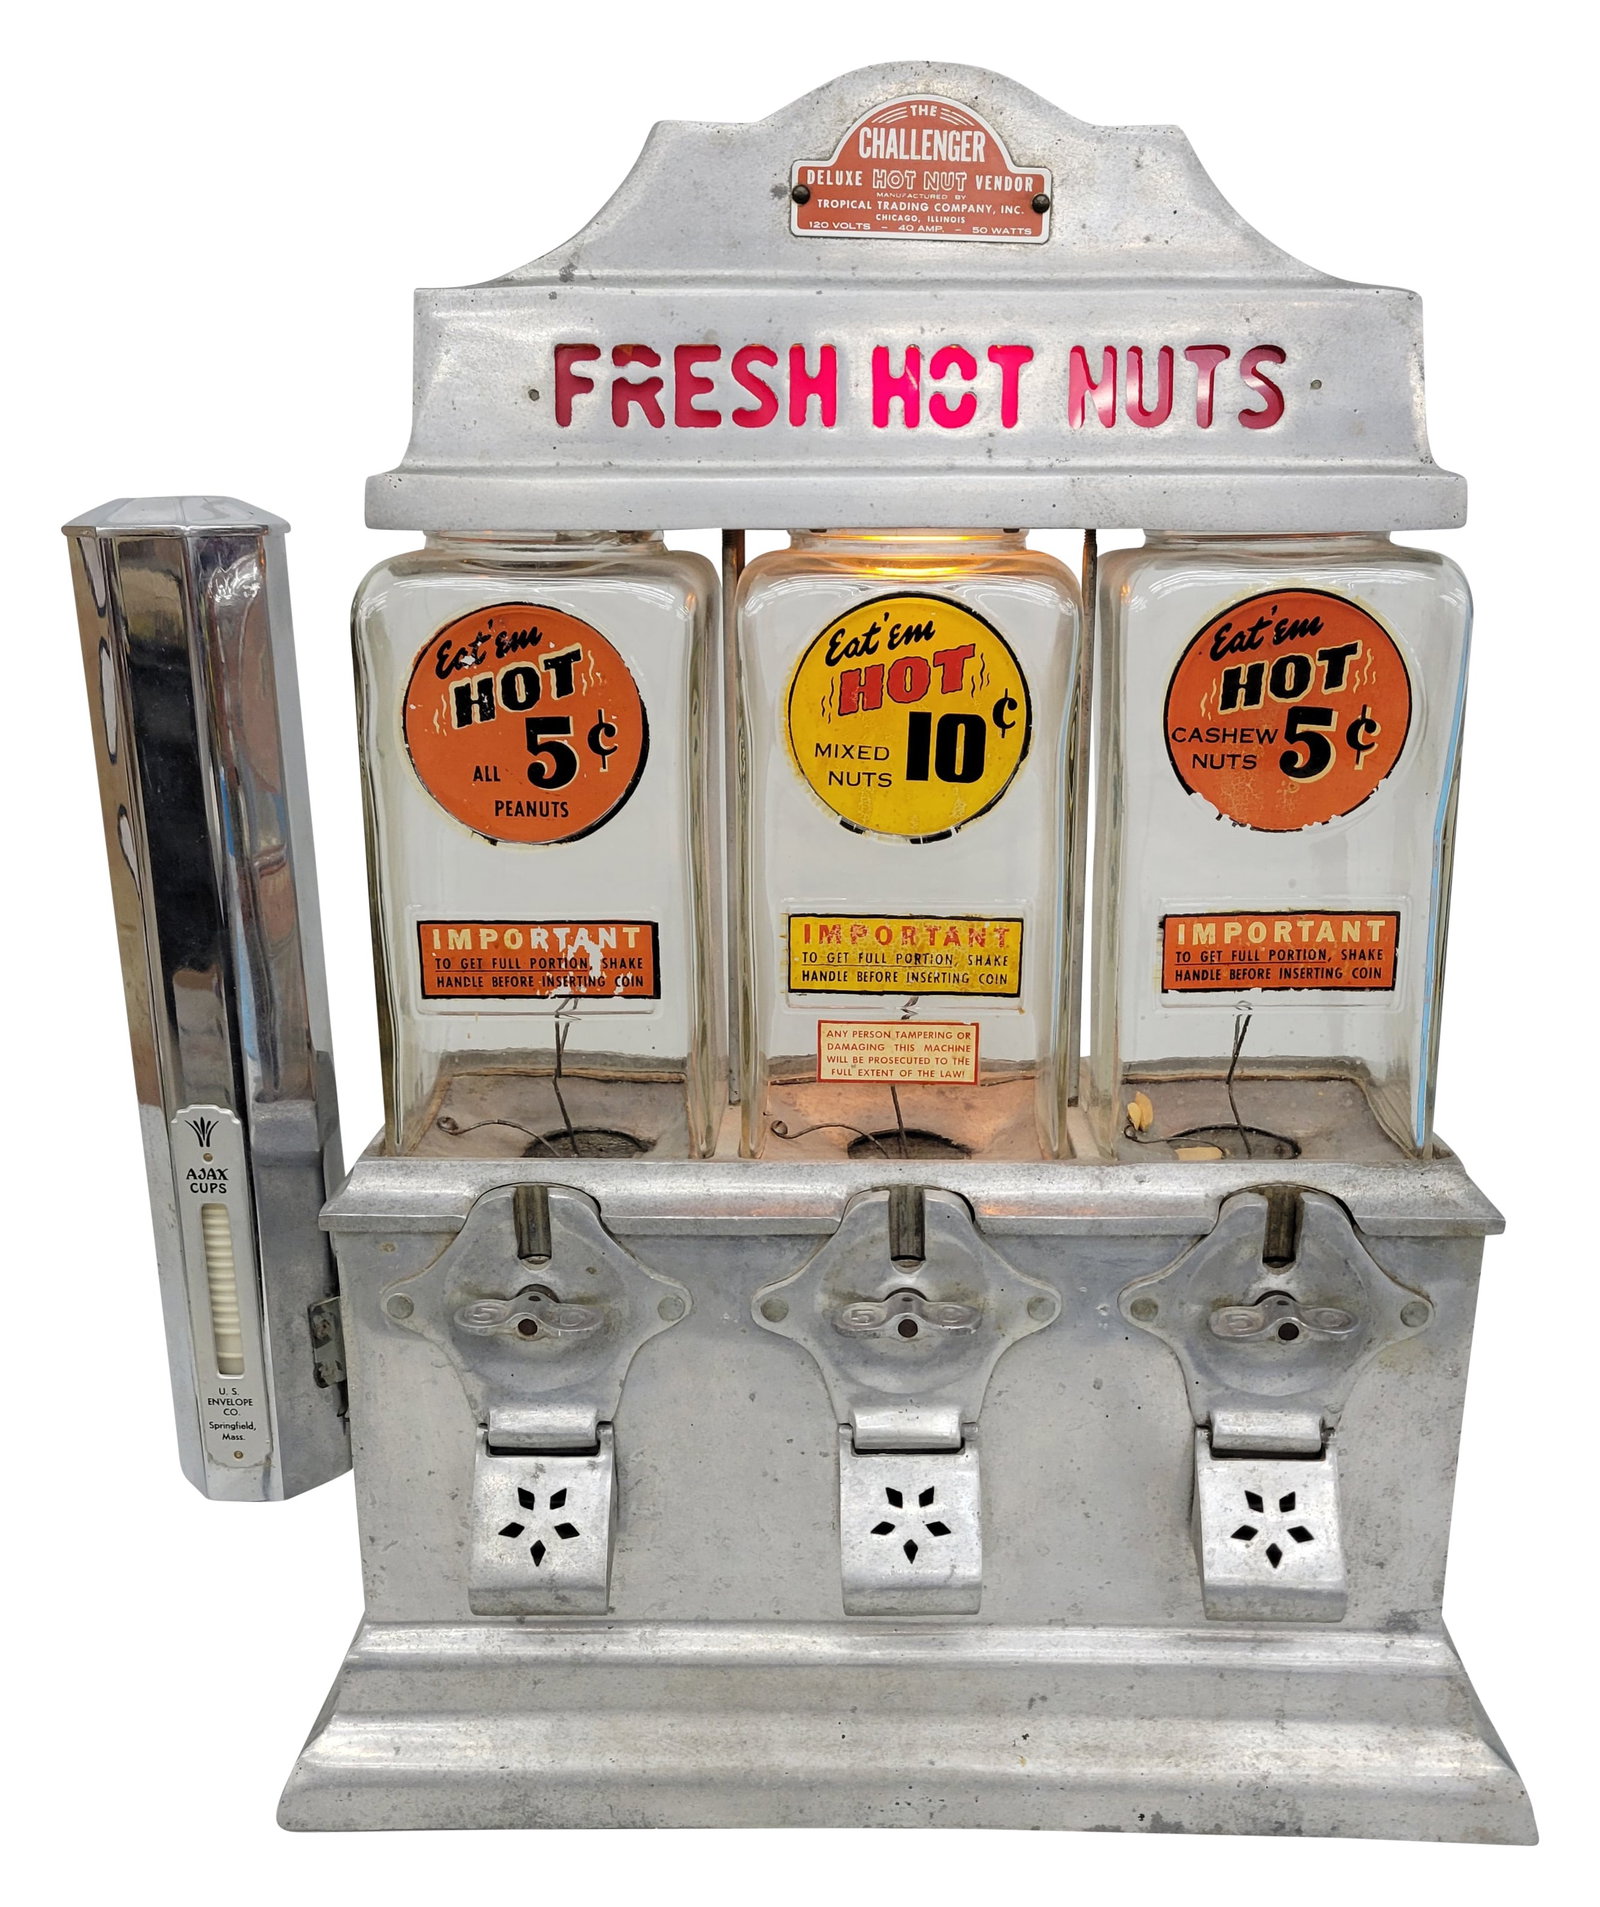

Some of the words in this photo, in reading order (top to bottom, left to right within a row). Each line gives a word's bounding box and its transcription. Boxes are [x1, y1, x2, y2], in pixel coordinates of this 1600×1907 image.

[909, 104, 938, 117] THE
[858, 126, 986, 162] CHALLENGER
[806, 169, 863, 186] DELUXE
[872, 168, 916, 189] HOT
[923, 170, 968, 192] NUT
[975, 175, 1034, 192] VENDOR
[876, 192, 948, 200] MANUFACTURED
[817, 199, 872, 210] TROPICAL
[877, 200, 930, 212] TRADING
[934, 202, 997, 215] COMPANY,
[1000, 204, 1025, 215] INC.
[927, 215, 966, 224] ILLINOIS
[808, 221, 829, 229] 120
[832, 221, 871, 230] VOLTS
[898, 224, 915, 232] 40
[917, 225, 945, 233] AMP.
[990, 227, 1032, 235] WATTS
[553, 343, 838, 429] FRESH
[871, 343, 1035, 430] HOT
[1067, 344, 1288, 429] NUTS
[838, 643, 976, 716] HOT
[1218, 640, 1363, 715] HOT
[449, 643, 583, 729] HOT
[1171, 727, 1278, 745] CASHEW
[814, 743, 890, 761] MIXED
[1191, 753, 1258, 770] NUTS
[472, 765, 501, 782] ALL
[828, 771, 893, 788] NUTS
[494, 800, 569, 817] PEANUTS
[431, 927, 640, 952] IMPORTANT
[803, 923, 1010, 948] IMPORTANT
[1177, 920, 1386, 946] IMPORTANT
[801, 952, 818, 964] TO
[826, 952, 850, 964] GET
[858, 952, 887, 965] FULL
[967, 954, 1009, 967] SHAKE
[1175, 951, 1191, 963] TO
[1200, 950, 1223, 963] GET
[1231, 949, 1260, 962] FULL
[1268, 948, 1332, 963] PORTION,
[1341, 948, 1384, 961] SHAKE
[435, 958, 452, 970] TO
[461, 958, 483, 970] GET
[492, 958, 521, 970] FULL
[530, 958, 593, 972] PORTION,
[602, 957, 644, 970] SHAKE
[801, 970, 848, 982] HANDLE
[856, 971, 899, 983] BEFORE
[906, 972, 970, 984] INSERTING
[978, 973, 1009, 985] COIN
[1175, 969, 1221, 982] HANDLE
[1229, 968, 1271, 980] BEFORE
[1279, 967, 1343, 980] INSERTING
[1351, 966, 1382, 979] COIN
[436, 976, 484, 988] HANDLE
[492, 976, 534, 988] BEFORE
[542, 976, 606, 988] INSERTING
[614, 976, 644, 987] COIN
[826, 1030, 848, 1038] ANY
[852, 1030, 891, 1039] PERSON
[895, 1031, 953, 1040] TAMPERING
[957, 1032, 971, 1040] OR
[827, 1043, 885, 1051] DAMAGING
[894, 1044, 915, 1052] THIS
[923, 1044, 971, 1053] MACHINE
[826, 1056, 848, 1064] WILL
[852, 1056, 864, 1064] BE
[868, 1056, 931, 1065] PROSECUTED
[935, 1057, 948, 1065] TO
[952, 1057, 970, 1066] THE
[831, 1068, 852, 1076] FULL
[858, 1069, 894, 1077] EXTENT
[899, 1069, 913, 1078] OF
[918, 1070, 935, 1078] THE
[940, 1070, 965, 1078] LAW!
[186, 1168, 229, 1180] AJAX
[190, 1182, 227, 1194] CUPS
[218, 1387, 228, 1396] U.
[231, 1387, 240, 1396] S.
[207, 1398, 253, 1406] ENVELOPE
[223, 1408, 240, 1416] CO.
[209, 1421, 256, 1431] Springfield,
